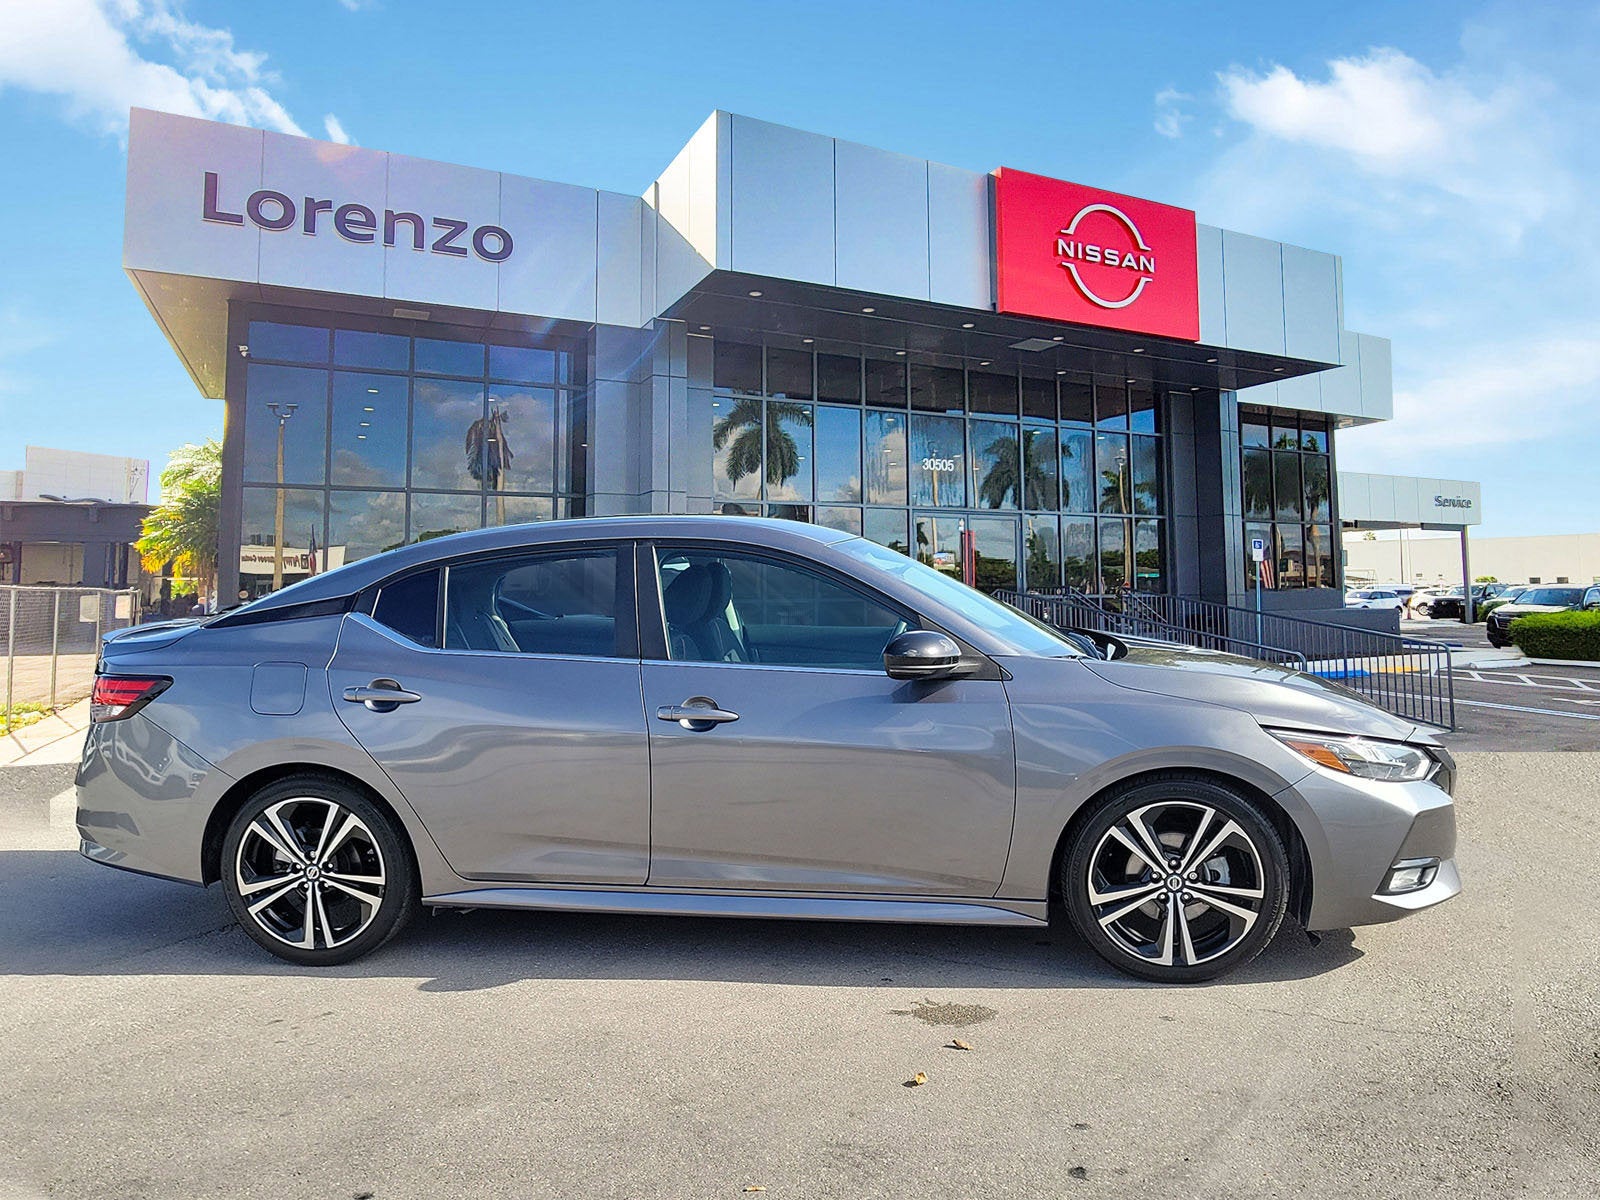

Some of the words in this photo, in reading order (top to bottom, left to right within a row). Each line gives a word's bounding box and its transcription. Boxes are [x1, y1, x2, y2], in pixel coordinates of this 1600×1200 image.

[203, 171, 514, 262] Lorenzo
[1057, 238, 1155, 273] NISSAN
[922, 457, 955, 471] 30505
[1434, 495, 1472, 509] Service
